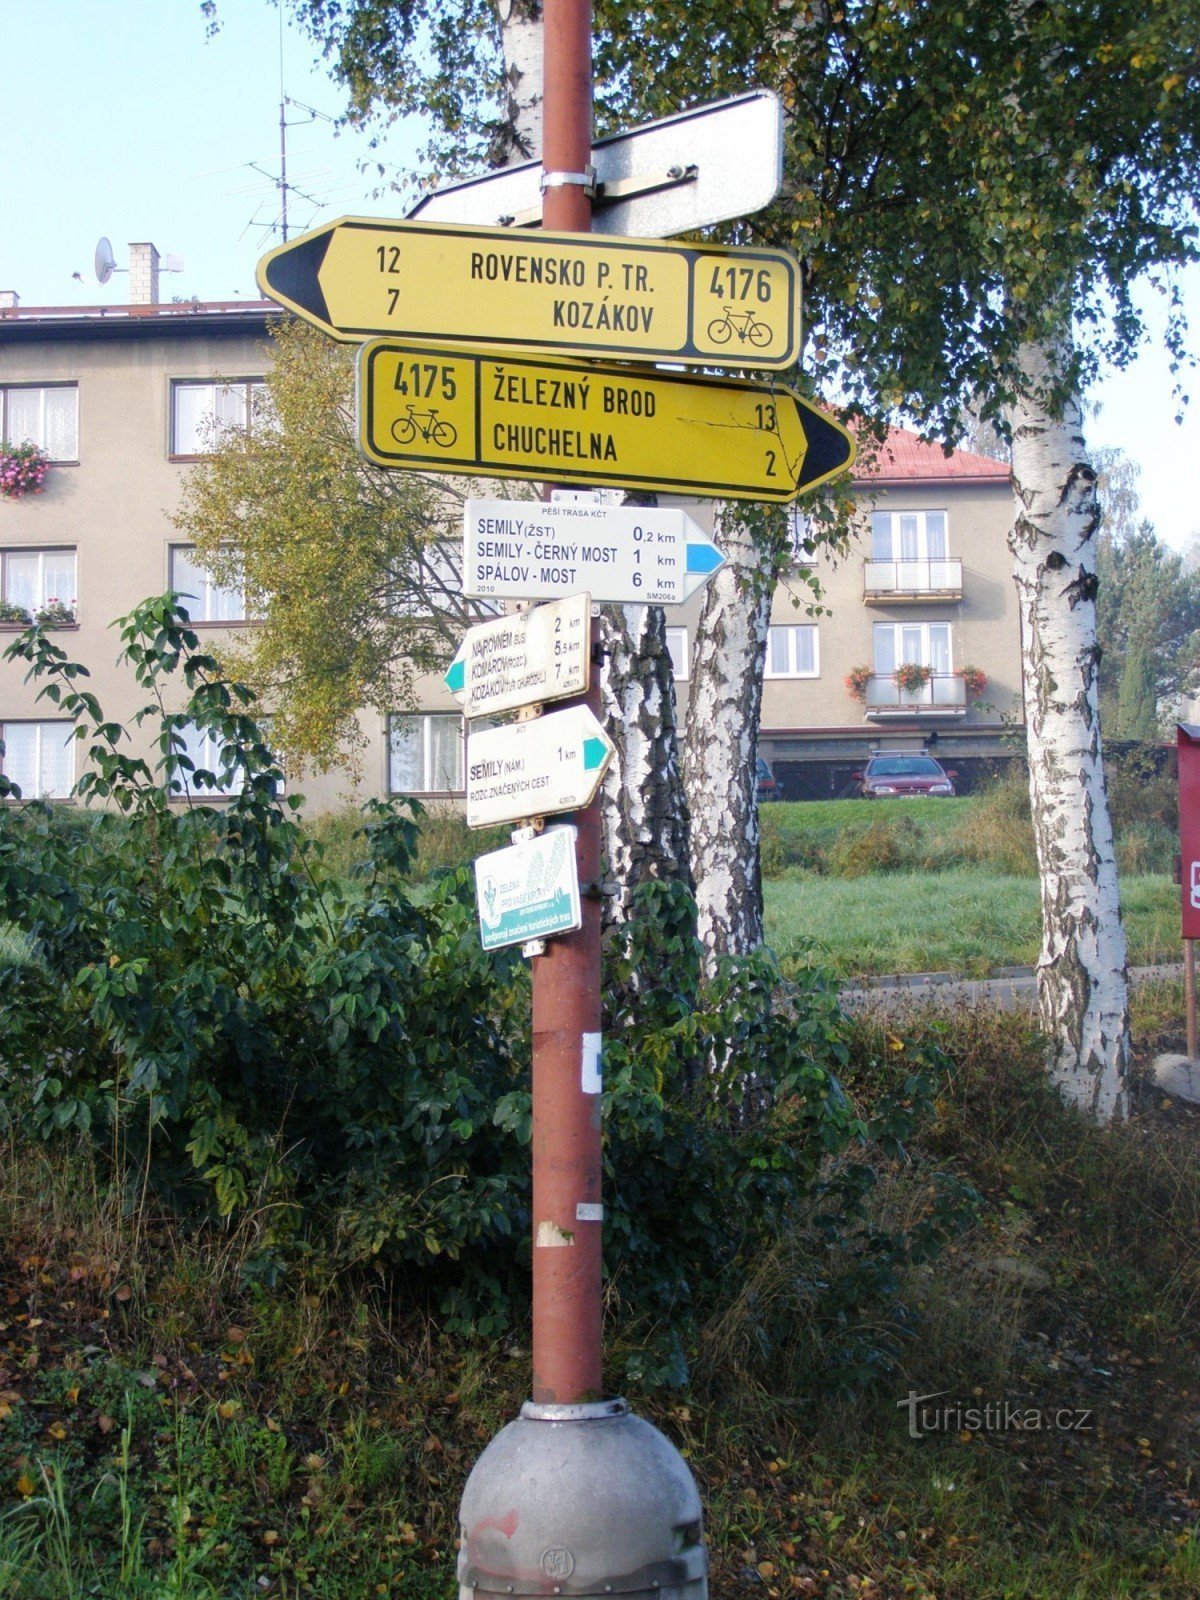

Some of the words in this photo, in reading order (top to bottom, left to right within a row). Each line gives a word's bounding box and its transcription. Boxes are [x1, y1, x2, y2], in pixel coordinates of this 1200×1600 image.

[377, 246, 401, 273] 12
[471, 252, 585, 288] ROVENSKO
[597, 262, 613, 289] P.
[622, 264, 654, 292] TR.
[710, 266, 772, 303] 4176
[387, 289, 400, 315] 7
[553, 295, 654, 333] KOZÁKOV
[393, 361, 456, 401] 4175
[494, 367, 591, 410] ŽELEZNÝ
[603, 387, 656, 417] BROD
[755, 404, 776, 431] 13
[494, 423, 618, 461] CHUCHELNA
[765, 451, 776, 476] 2
[562, 509, 589, 518] TRASA
[657, 533, 676, 544] km
[477, 542, 523, 559] SEMILY
[534, 541, 577, 562] ČERNÝ
[582, 547, 617, 563] MOST
[633, 549, 641, 564] 1
[657, 556, 676, 566] km
[477, 565, 529, 582] SPÁLOV
[540, 568, 576, 585] MOST
[632, 572, 643, 588] 6
[657, 579, 675, 589] km
[554, 617, 561, 633] 2
[569, 618, 581, 629] km
[568, 641, 580, 651] km
[555, 664, 561, 680] 7
[568, 664, 580, 675] km
[557, 747, 563, 762] 1
[565, 750, 576, 760] km
[470, 760, 504, 781] SEMILY
[531, 775, 550, 790] CEST
